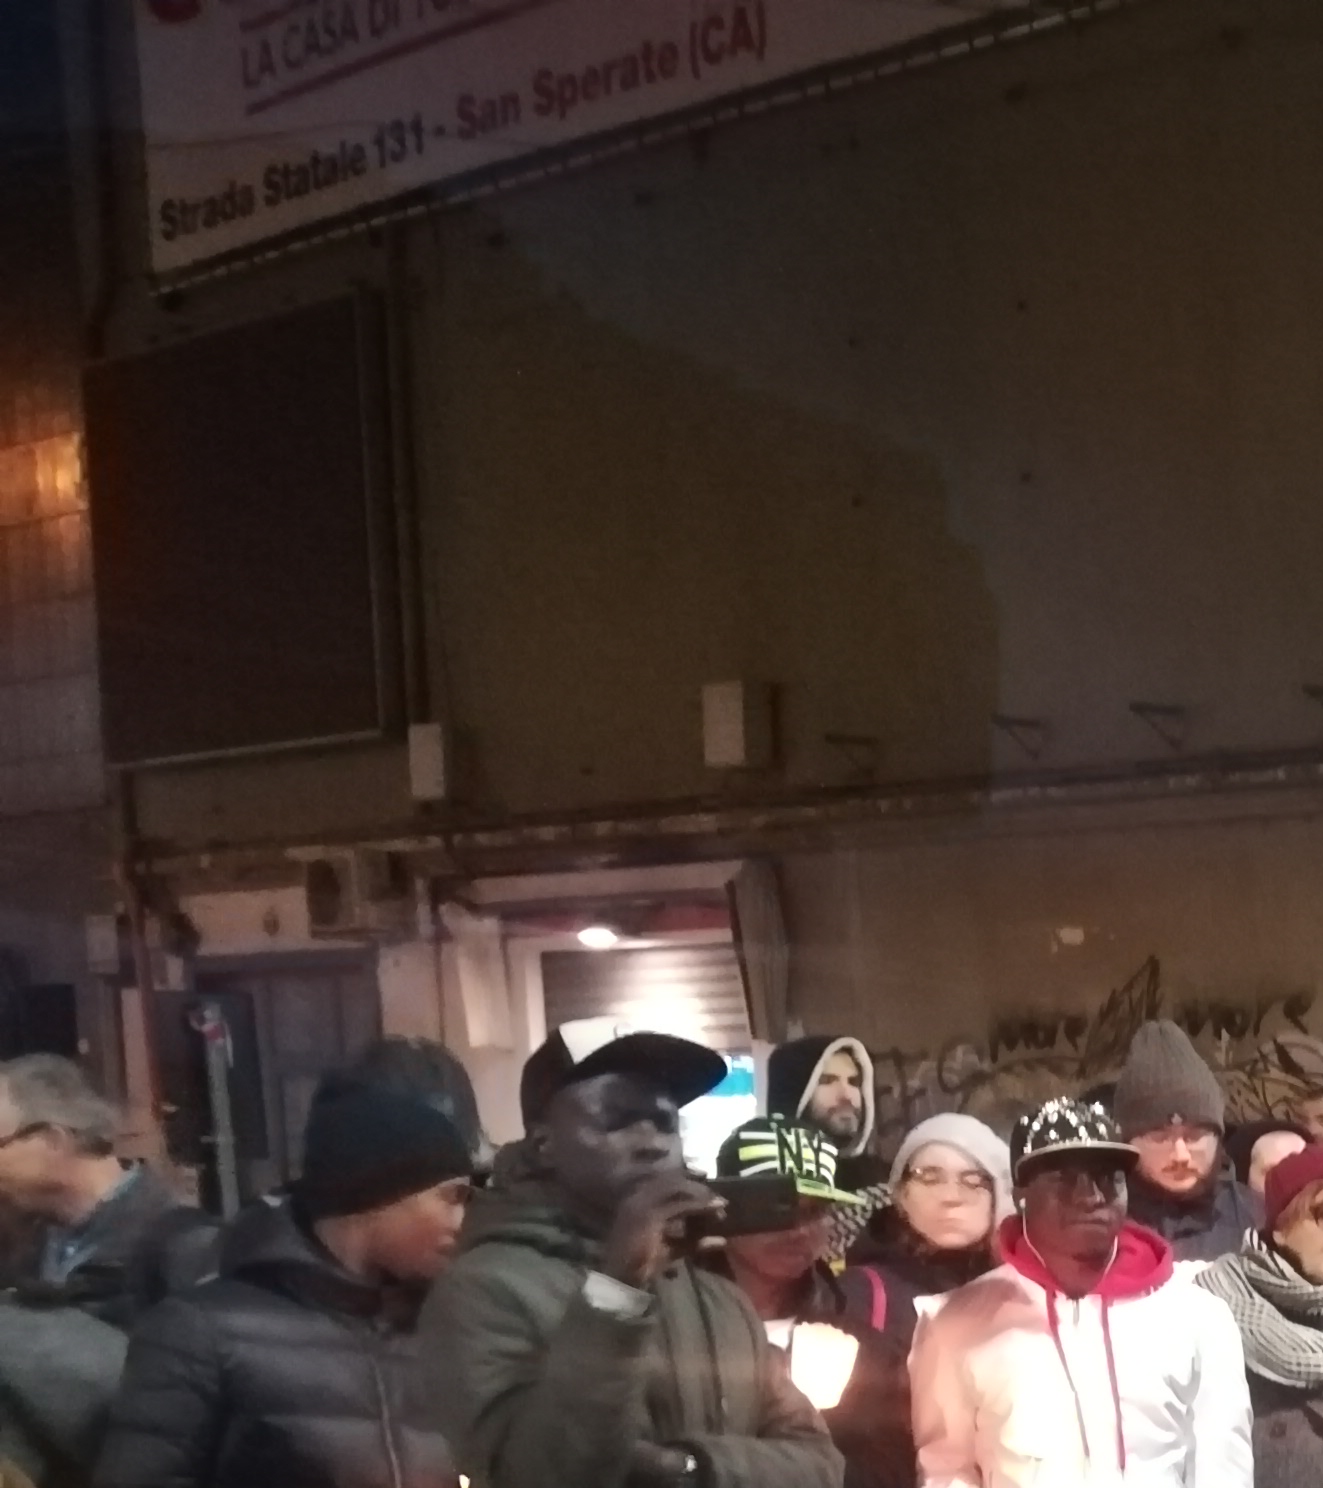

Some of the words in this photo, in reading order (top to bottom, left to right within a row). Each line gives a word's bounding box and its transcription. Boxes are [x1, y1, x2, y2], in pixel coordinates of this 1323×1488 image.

[242, 39, 277, 89] LA
[282, 0, 361, 69] CASA
[159, 194, 255, 240] Strada
[262, 139, 368, 205] Statale
[373, 113, 424, 169] 131
[455, 91, 523, 139] San
[531, 39, 680, 119] Sperate
[688, 5, 768, 79] (CA)
[774, 1122, 823, 1178] NY
